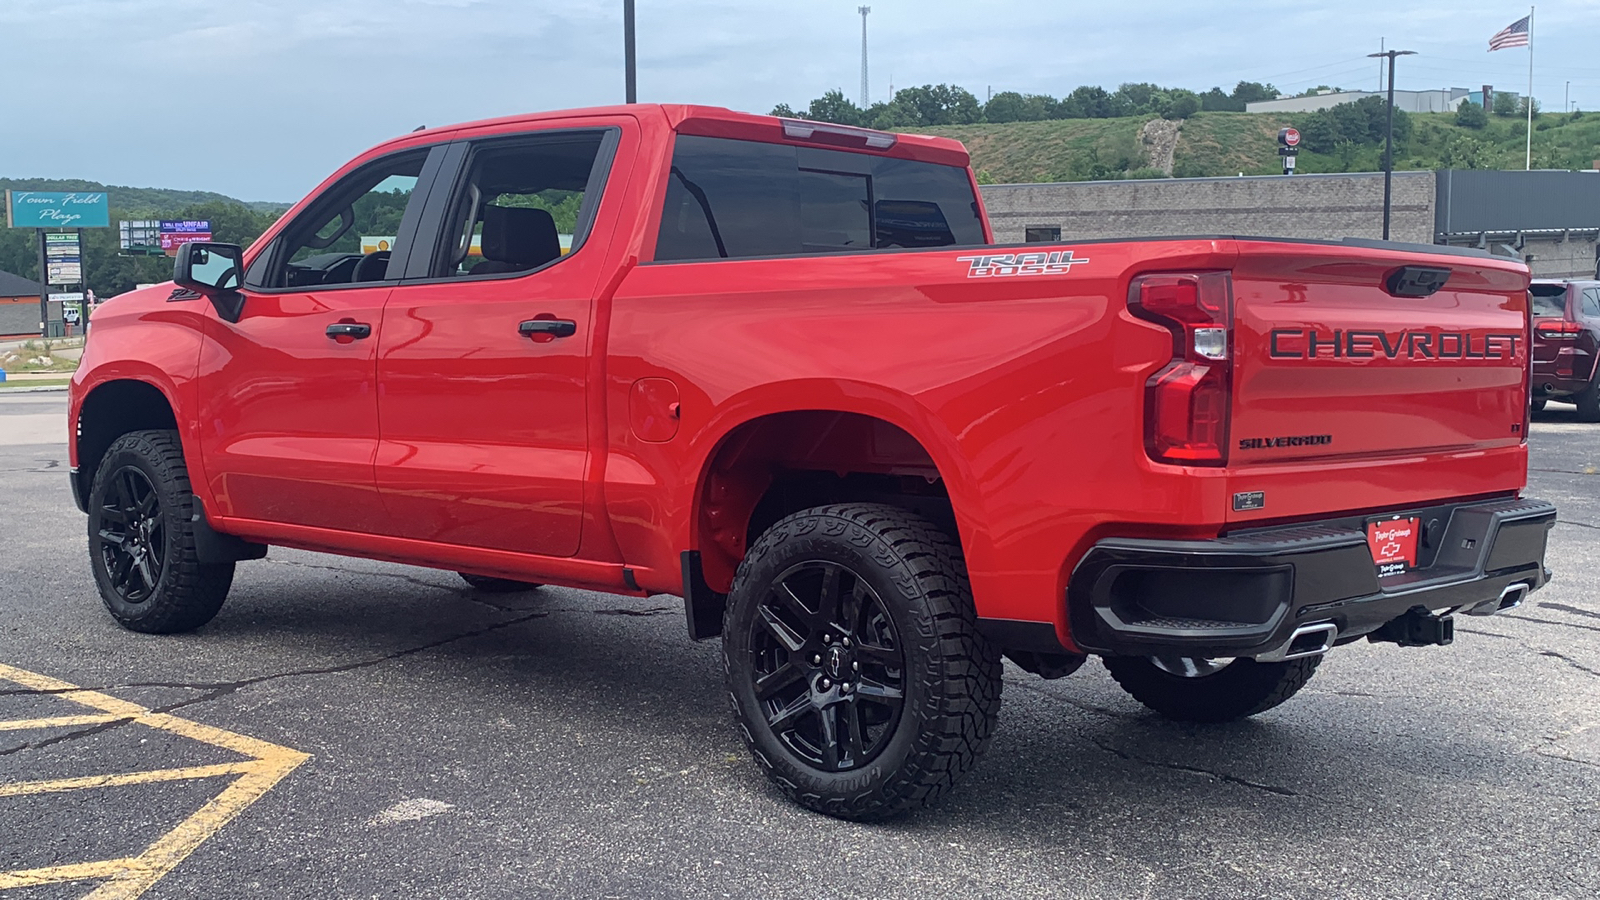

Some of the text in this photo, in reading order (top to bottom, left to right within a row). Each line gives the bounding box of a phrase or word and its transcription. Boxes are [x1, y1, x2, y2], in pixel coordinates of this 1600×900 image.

[18, 192, 101, 206] Town Field
[39, 208, 82, 225] Plaza
[957, 251, 1090, 267] TRAIL
[967, 263, 1071, 278] BOSS
[1270, 328, 1522, 360] CHEVROLET
[1238, 434, 1333, 450] SILVERADO
